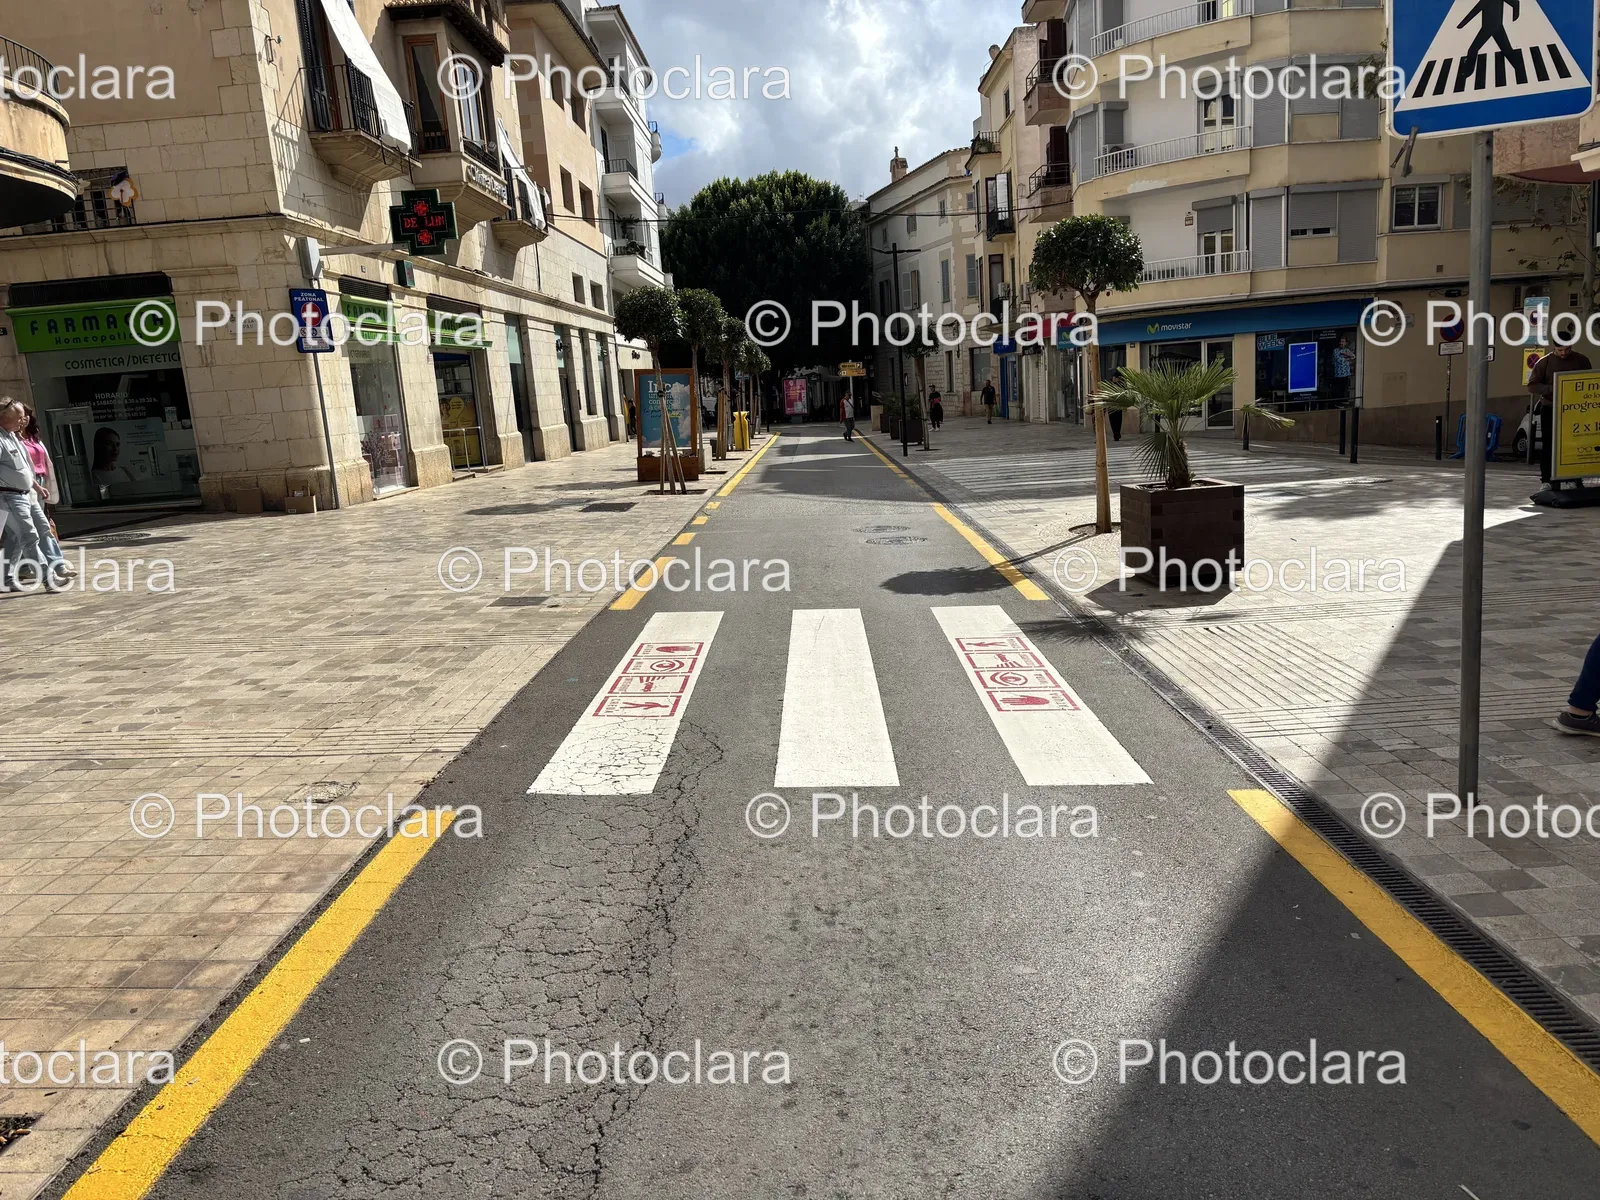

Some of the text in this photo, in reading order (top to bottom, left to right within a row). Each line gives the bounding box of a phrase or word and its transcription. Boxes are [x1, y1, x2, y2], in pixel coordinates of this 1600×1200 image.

[404, 217, 418, 229] DE
[29, 311, 164, 336] FARMACA
[1161, 322, 1192, 332] movistar
[1258, 333, 1278, 344] BLUE
[1257, 338, 1286, 351] WEEKS
[1575, 381, 1584, 391] El
[1573, 423, 1580, 433] 2
[1584, 424, 1590, 432] x
